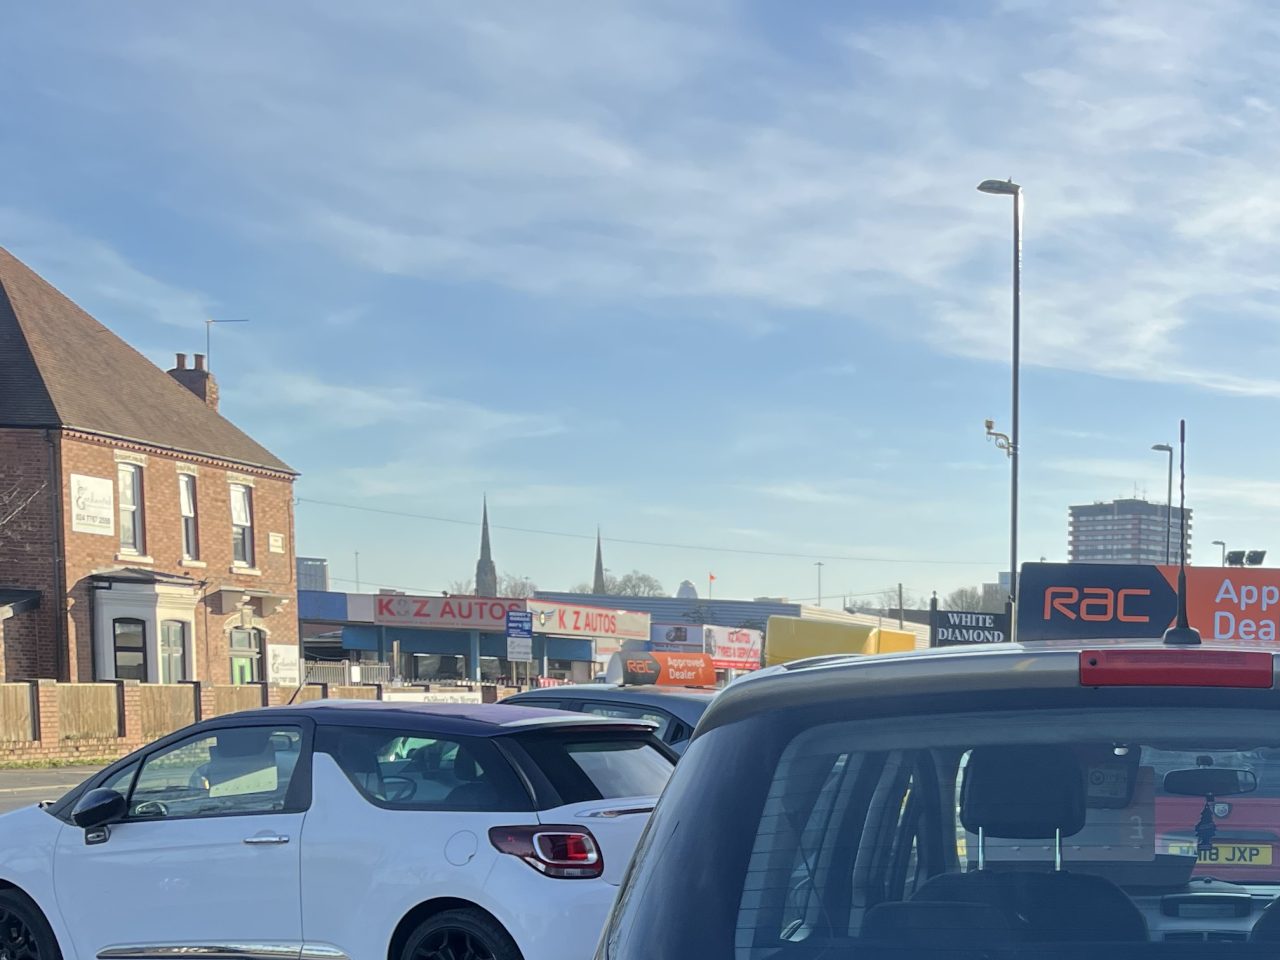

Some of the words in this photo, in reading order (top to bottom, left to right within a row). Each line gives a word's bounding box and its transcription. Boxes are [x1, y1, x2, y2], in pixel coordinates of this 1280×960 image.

[558, 608, 566, 629] K
[573, 611, 582, 631] Z
[584, 612, 616, 634] AUTOS
[948, 613, 994, 627] WHITE
[938, 628, 1004, 642] DIAMOND
[667, 657, 705, 669] Approved
[669, 668, 696, 679] Dealer
[1225, 847, 1260, 862] JXP
